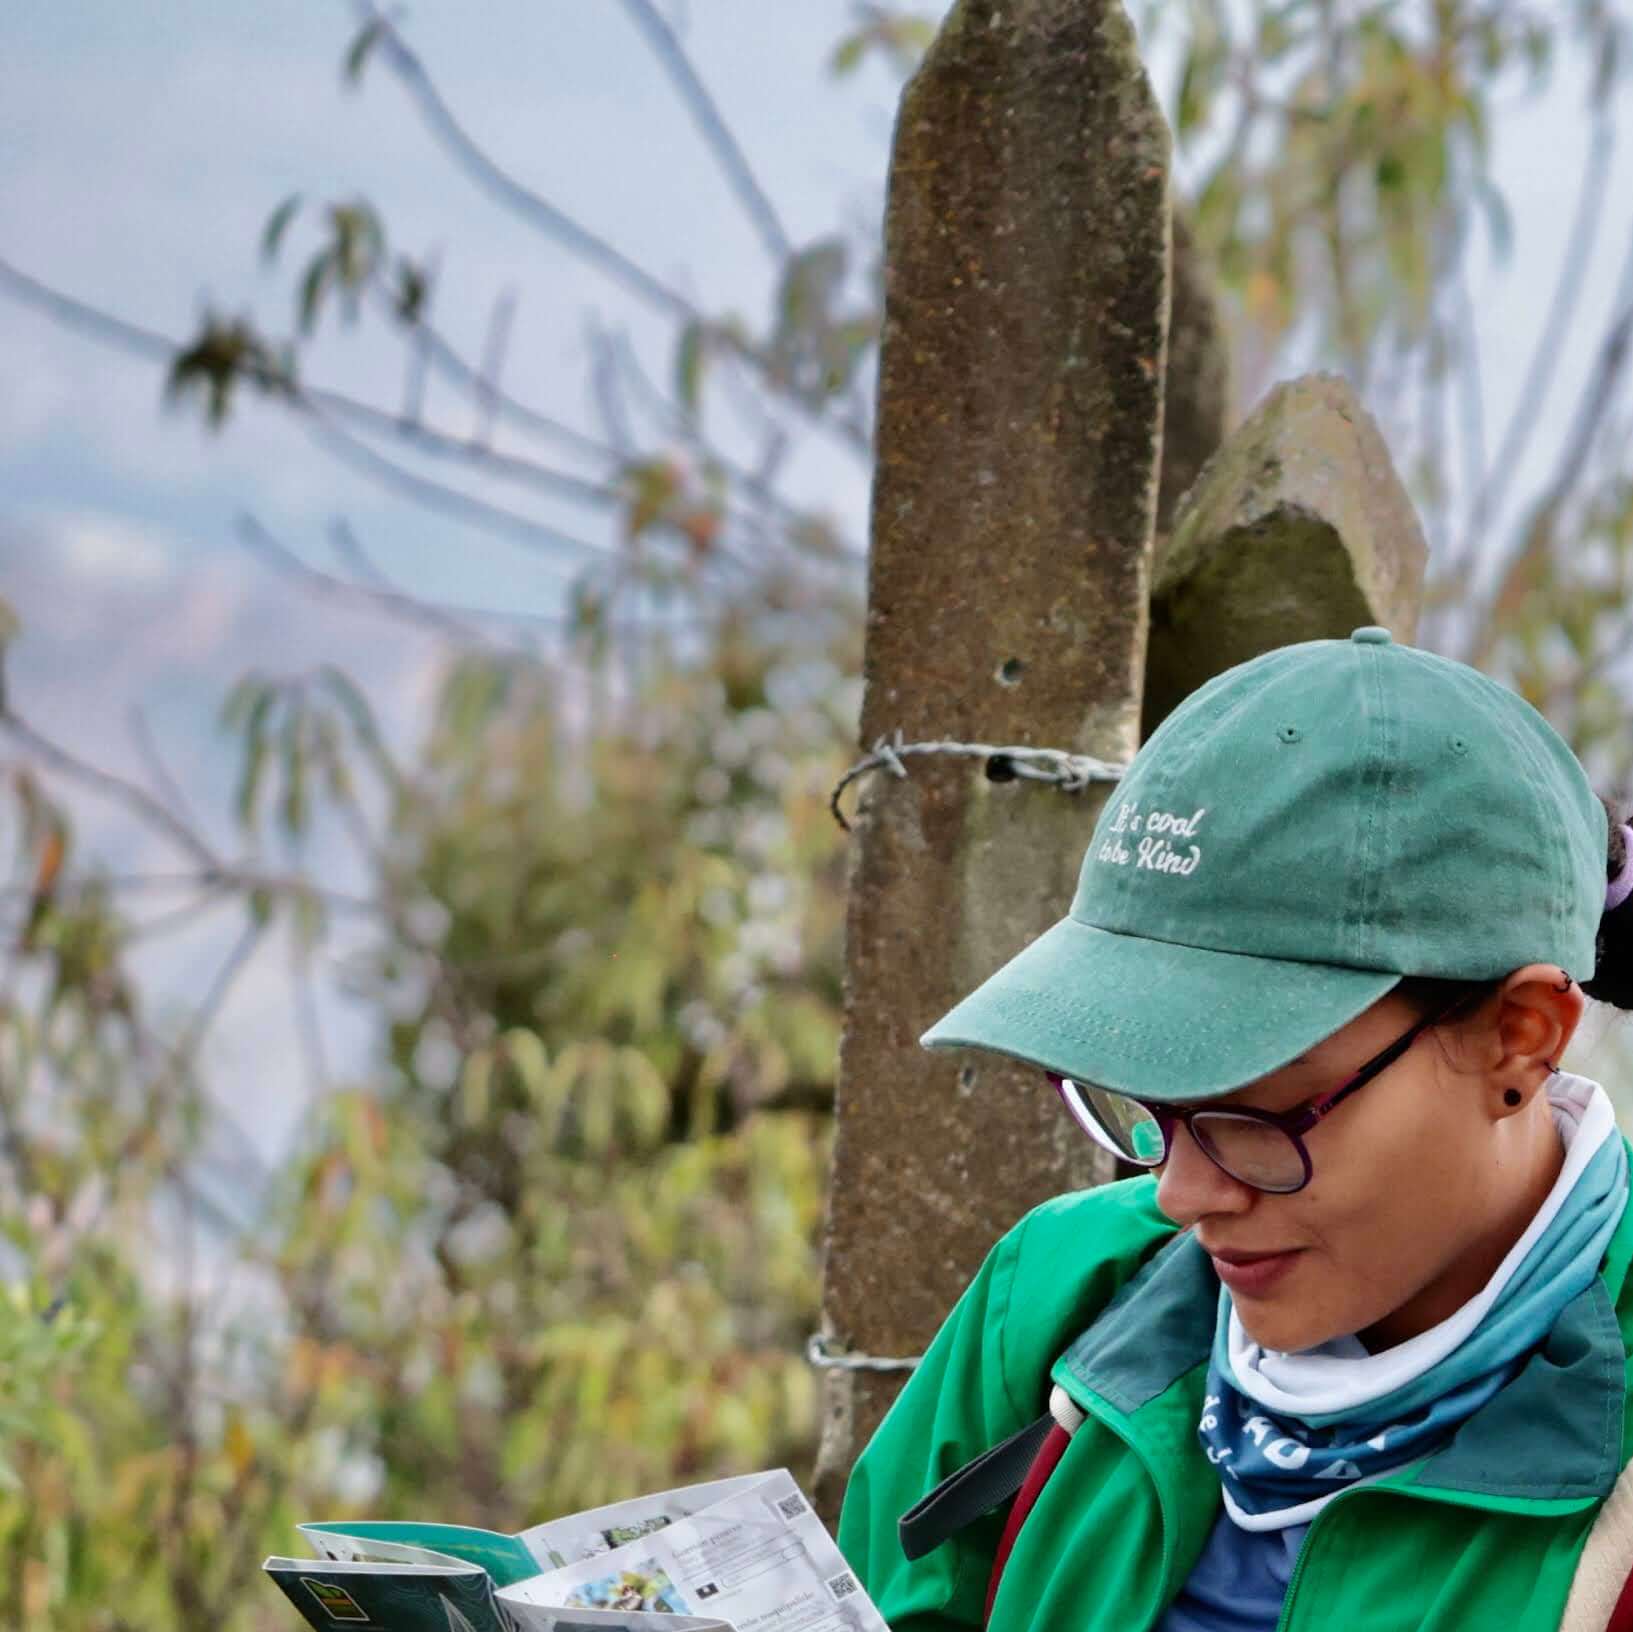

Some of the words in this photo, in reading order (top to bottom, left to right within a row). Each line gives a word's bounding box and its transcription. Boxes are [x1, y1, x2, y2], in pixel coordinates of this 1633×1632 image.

[1109, 801, 1142, 832] It's
[1146, 808, 1205, 837] cool
[1136, 836, 1201, 875] Kind
